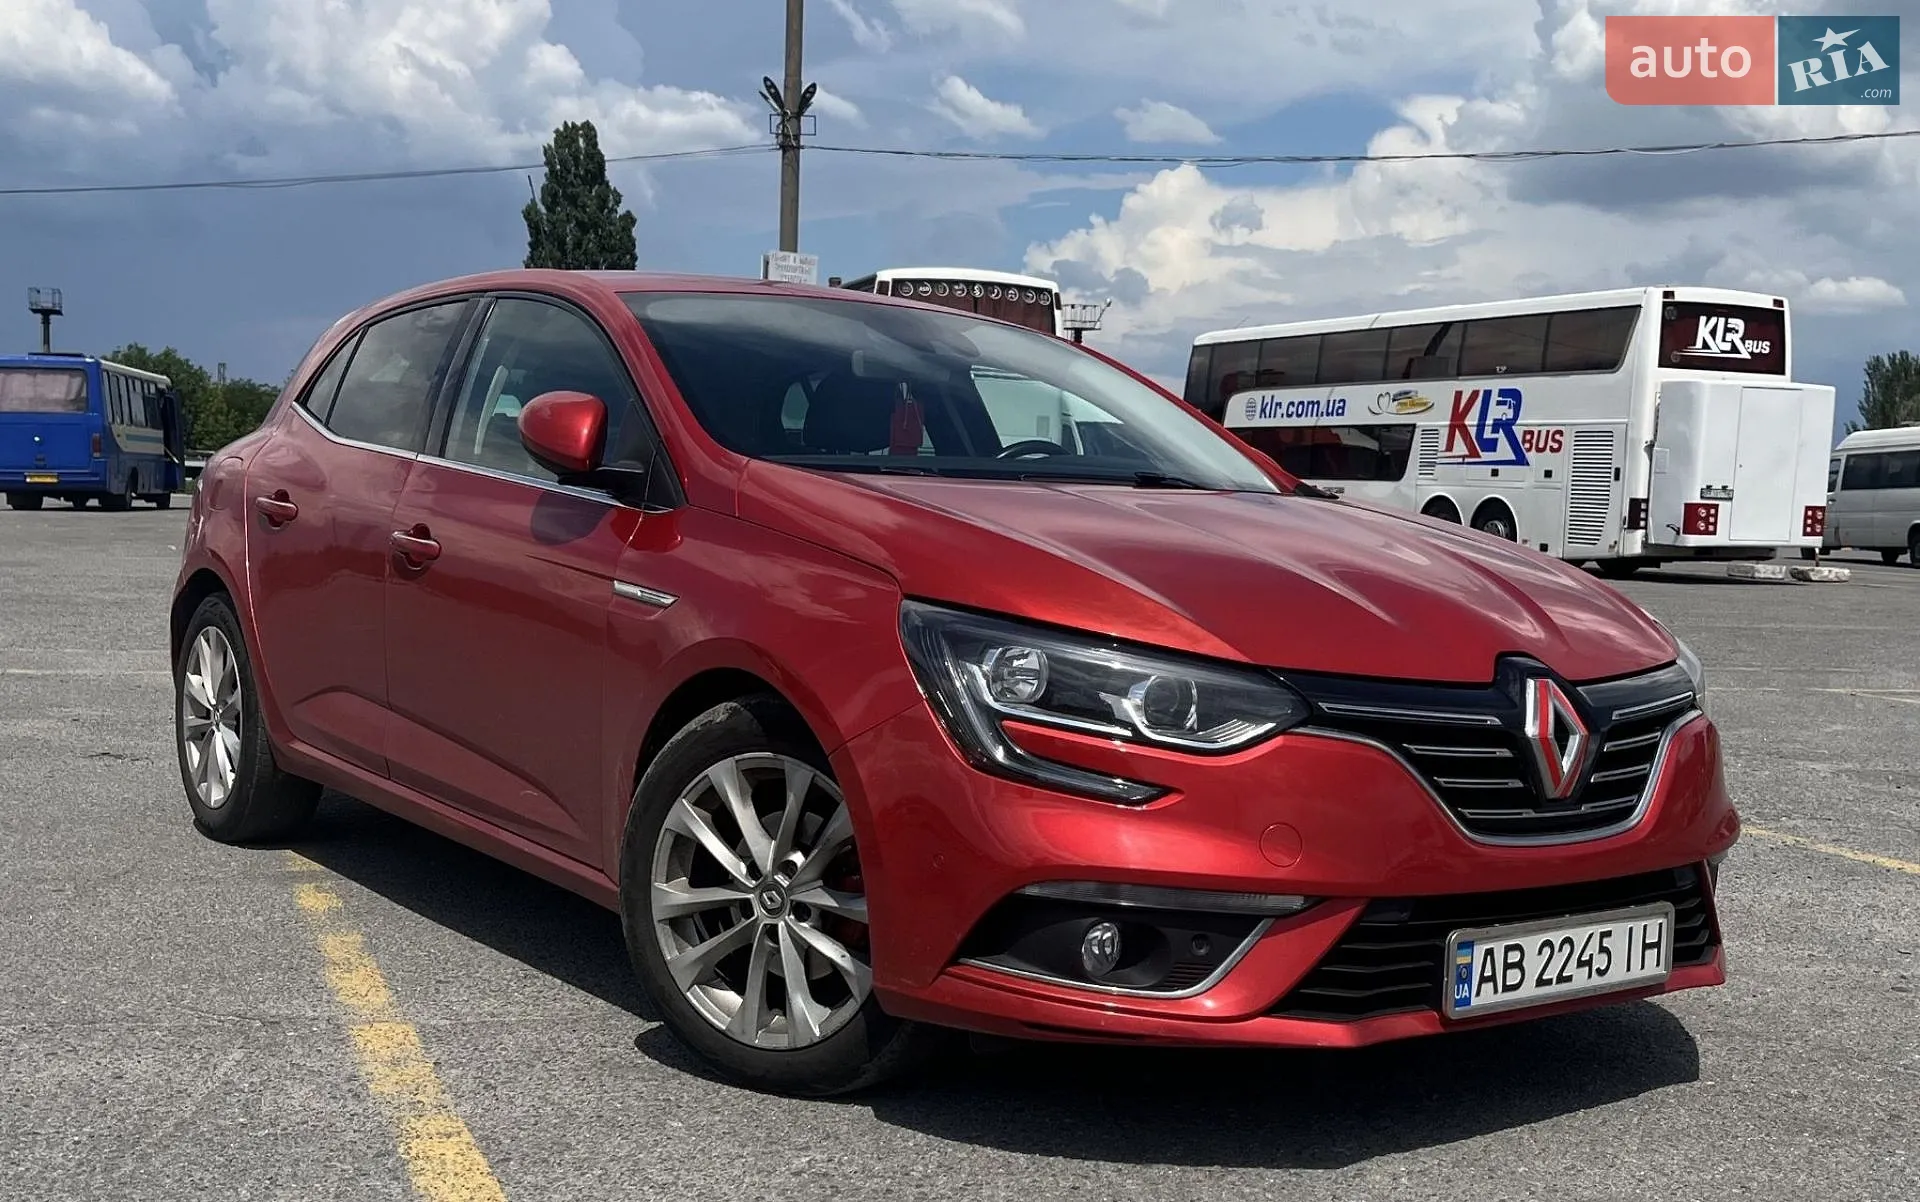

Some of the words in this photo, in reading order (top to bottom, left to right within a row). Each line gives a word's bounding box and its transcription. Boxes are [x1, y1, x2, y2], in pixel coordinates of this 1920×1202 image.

[1682, 315, 1752, 360] KLR
[1744, 339, 1771, 354] BUS
[1259, 394, 1346, 419] klr.com.ua
[1440, 387, 1530, 467] KLR
[1521, 429, 1564, 454] BUS
[1475, 942, 1526, 998] AB
[1534, 929, 1613, 988] 2245
[1626, 921, 1663, 973] IH
[1454, 983, 1470, 999] UA
